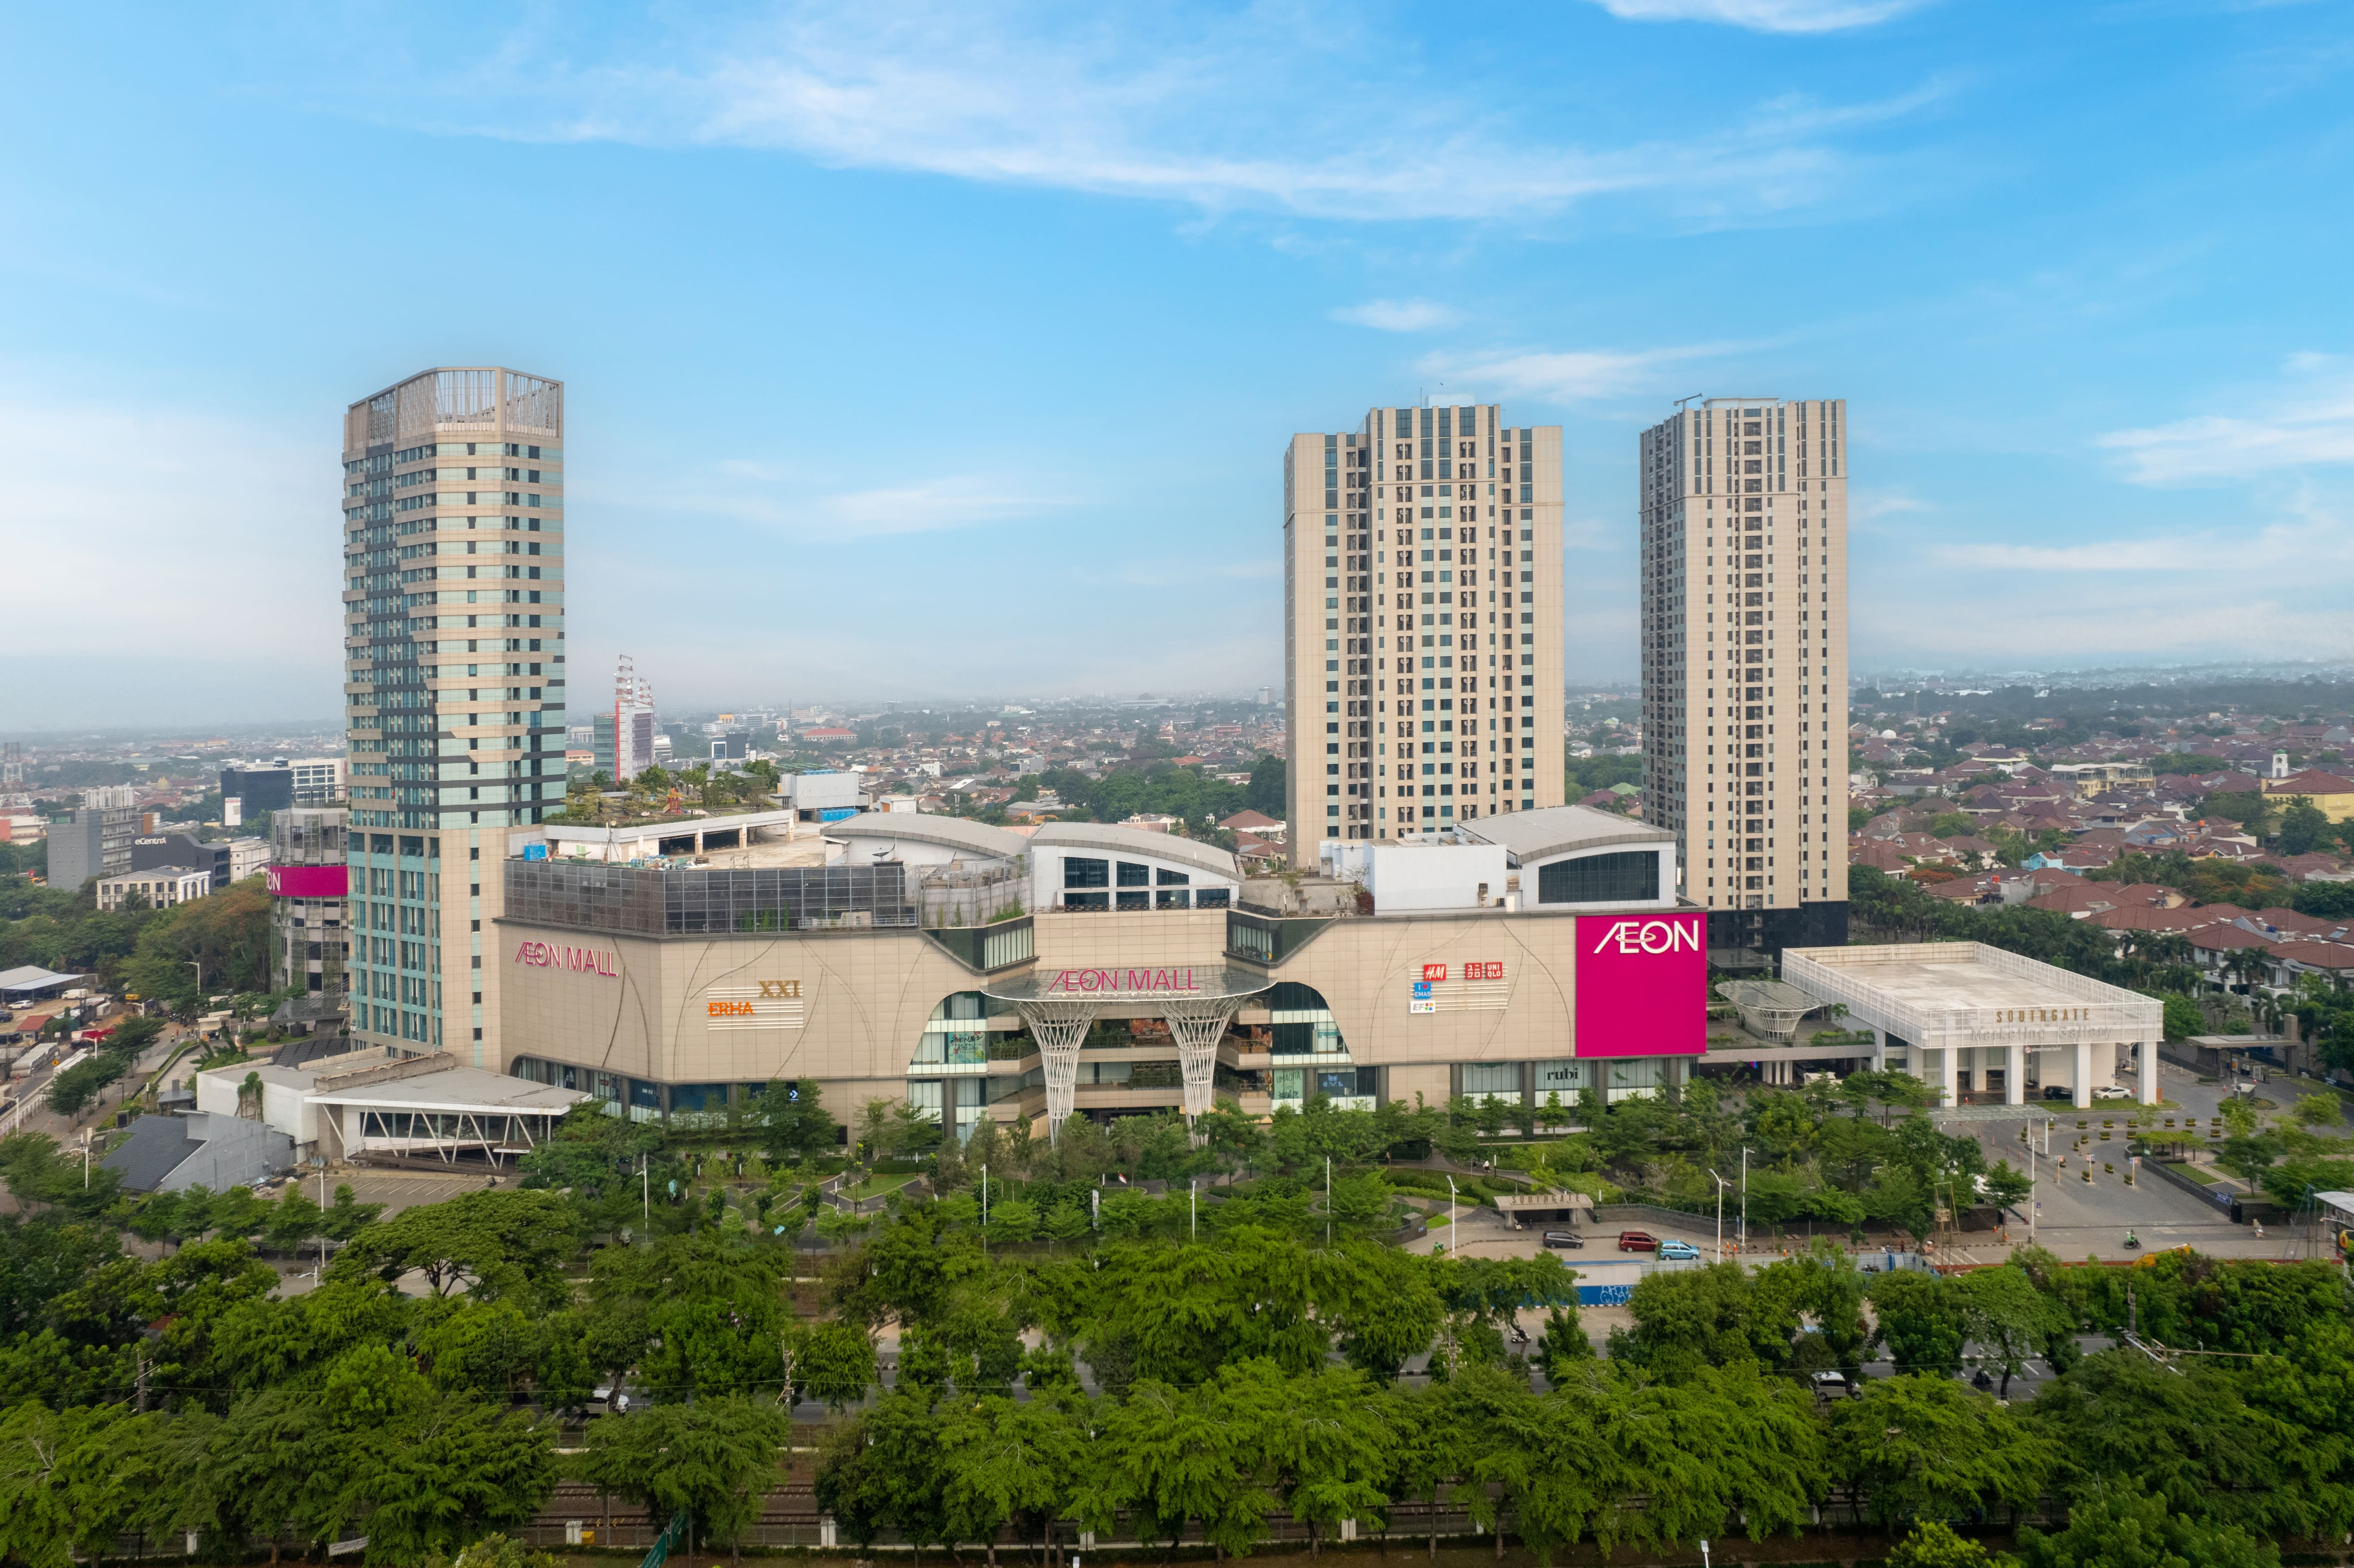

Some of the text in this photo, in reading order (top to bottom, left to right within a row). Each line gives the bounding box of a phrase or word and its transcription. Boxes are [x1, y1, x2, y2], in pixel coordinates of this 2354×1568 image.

[567, 946, 619, 977] MALL
[1128, 968, 1200, 991] MALL
[1426, 966, 1445, 979] H&M
[758, 980, 800, 998] XXI
[708, 1001, 754, 1016] ERHA
[1996, 1008, 2089, 1023] SOUTHGATE
[1547, 1067, 1578, 1080] rubi
[1512, 1194, 1580, 1204] SOUTHGATE
